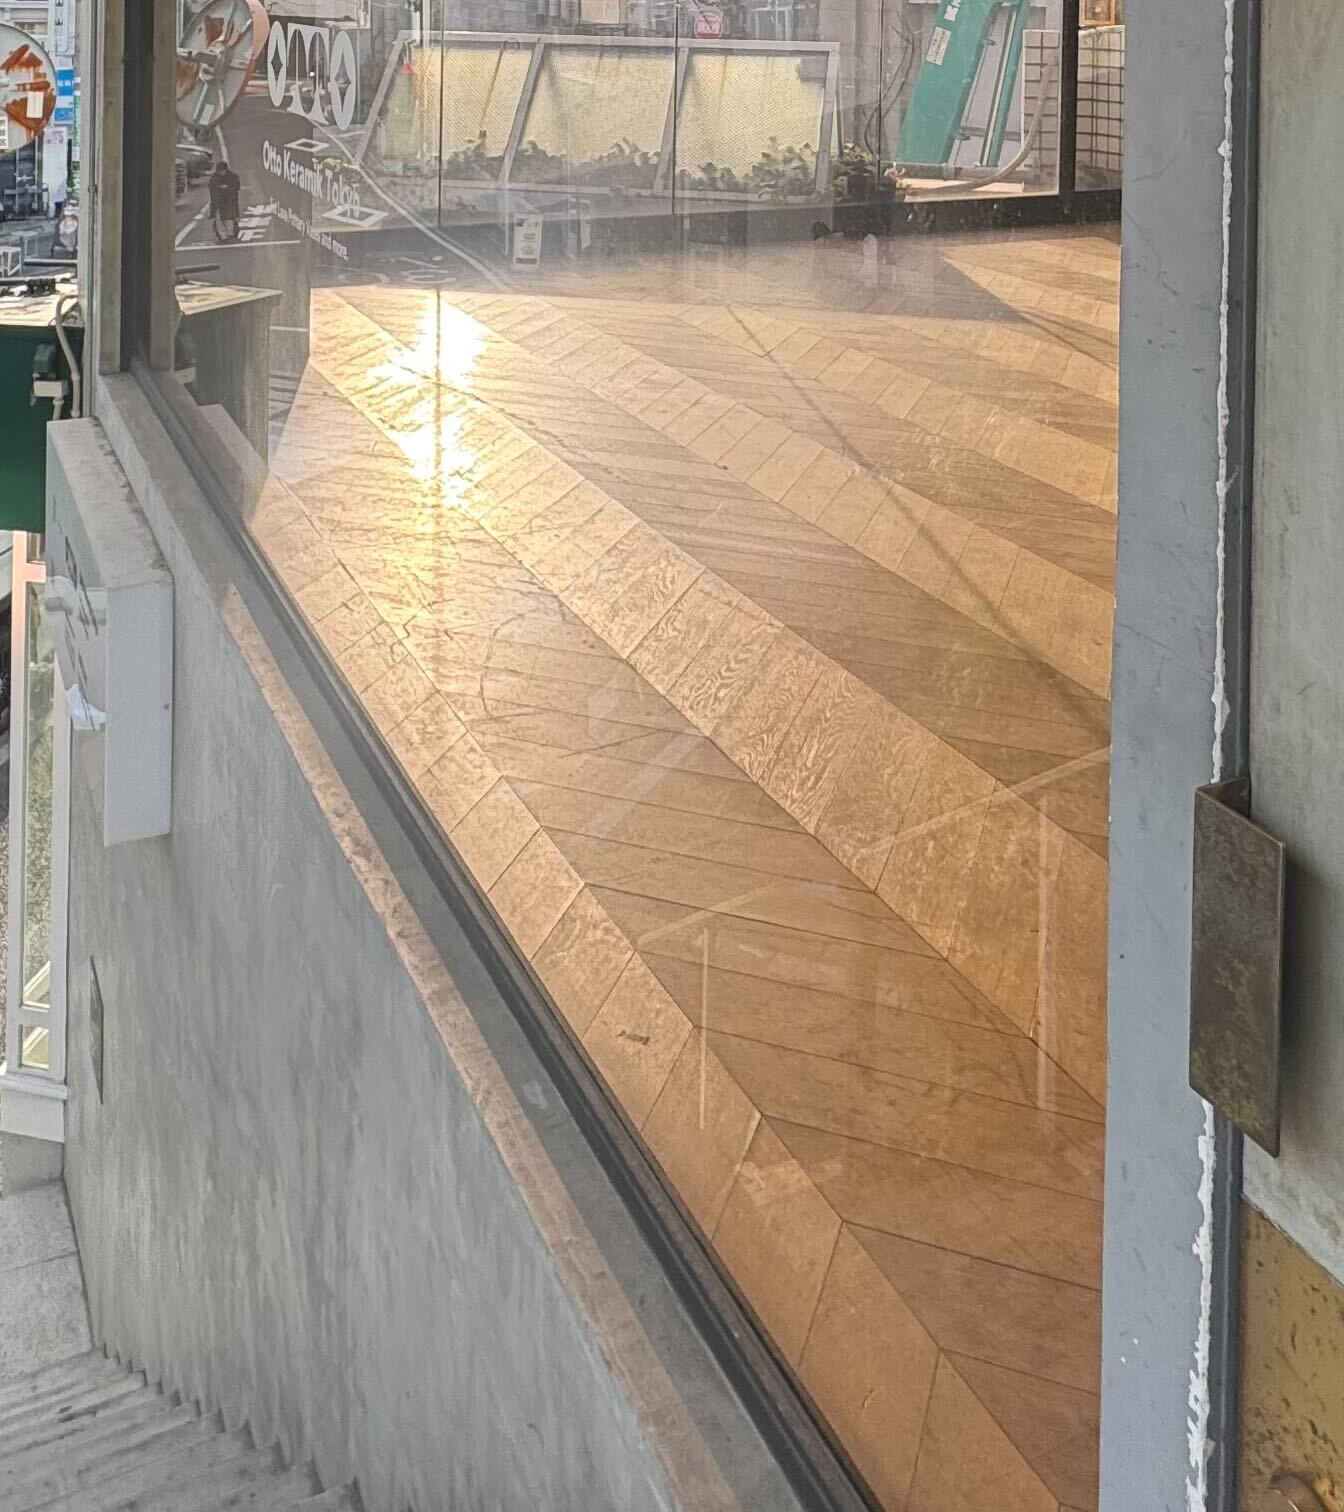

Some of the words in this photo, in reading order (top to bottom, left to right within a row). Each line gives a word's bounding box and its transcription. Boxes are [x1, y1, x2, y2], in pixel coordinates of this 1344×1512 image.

[267, 20, 356, 131] OTTO
[263, 140, 282, 176] Otto
[283, 149, 323, 199] Keramik
